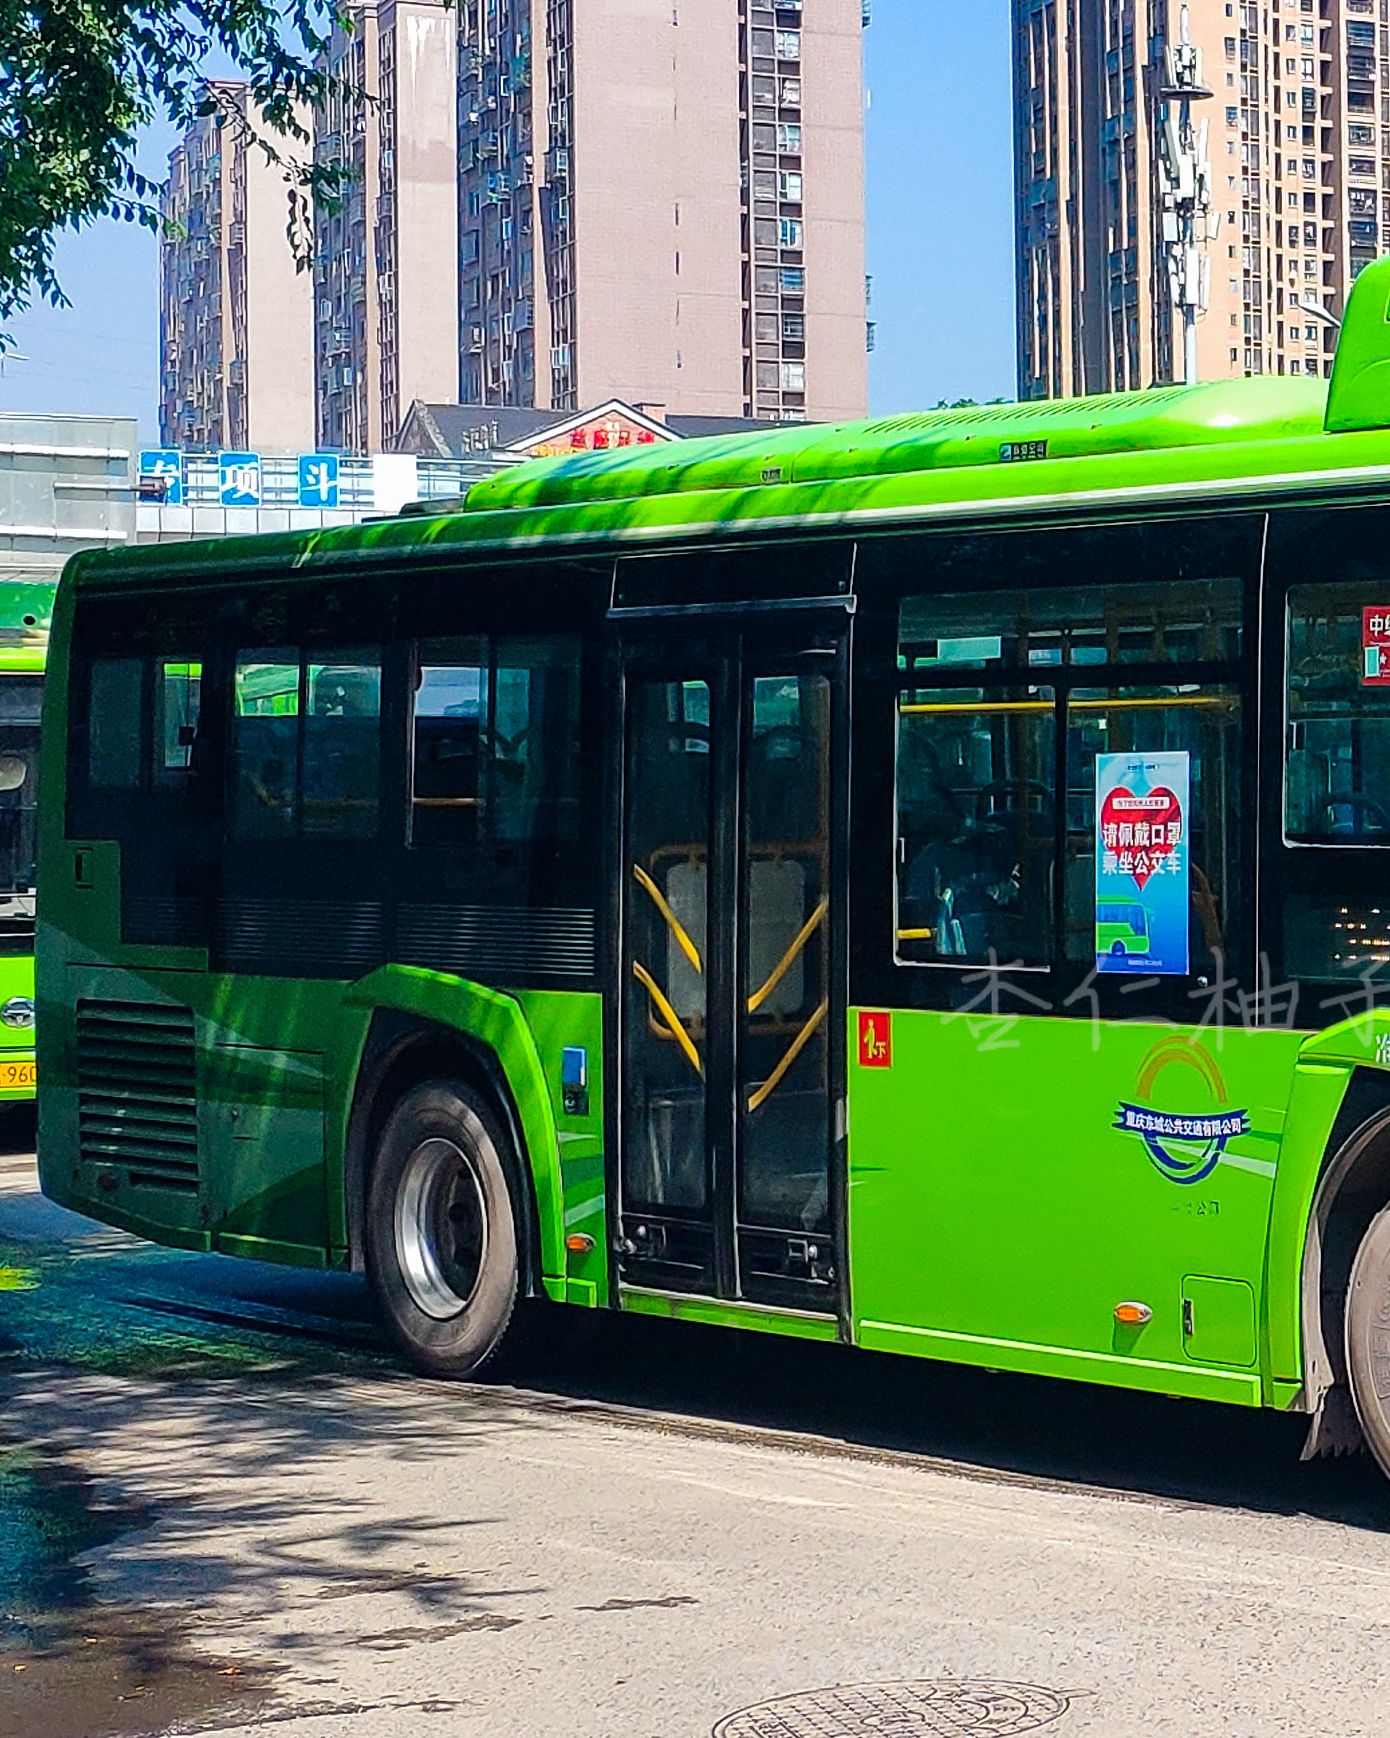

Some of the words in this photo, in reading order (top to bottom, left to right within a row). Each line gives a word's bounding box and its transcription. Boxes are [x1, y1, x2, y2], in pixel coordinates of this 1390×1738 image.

[1102, 822, 1182, 847] 请佩戴口罩
[1102, 850, 1182, 876] 乘坐公交车
[875, 1041, 886, 1059] 下
[1125, 1110, 1242, 1137] 重庆东城公共交通有限公司
